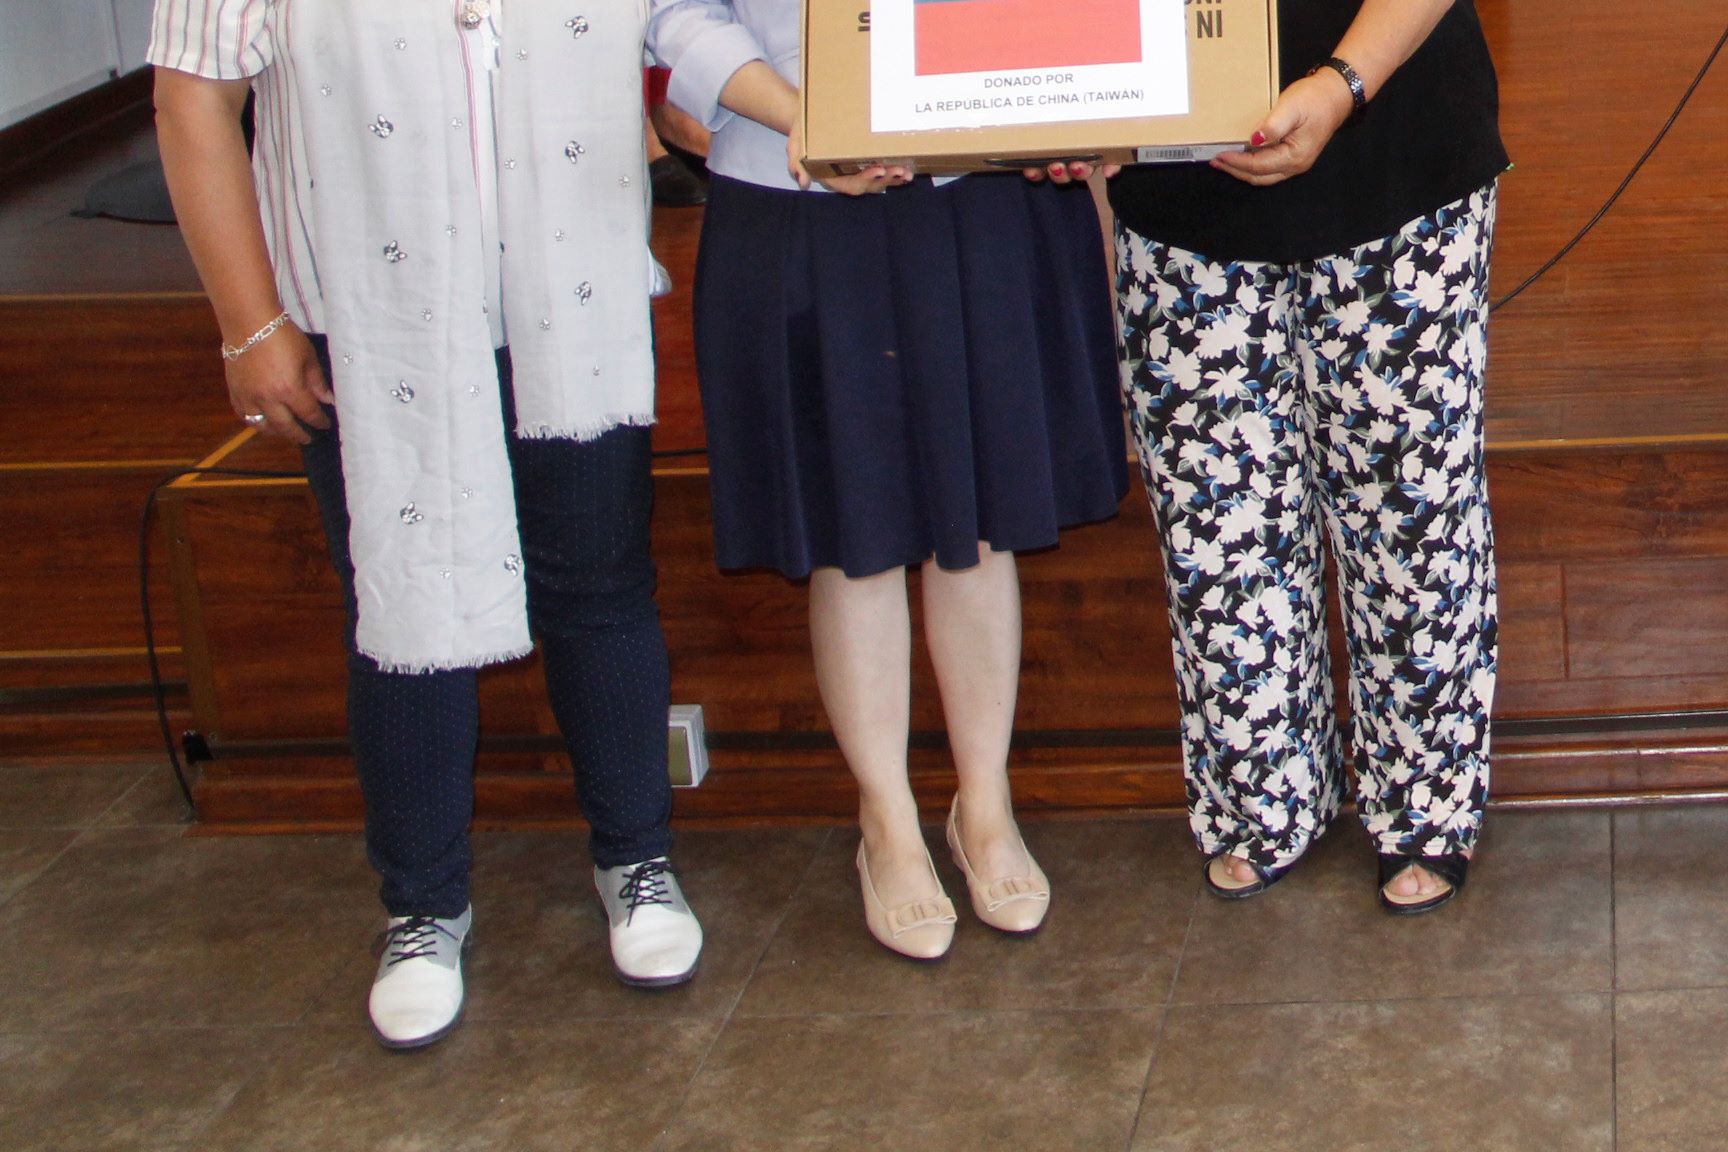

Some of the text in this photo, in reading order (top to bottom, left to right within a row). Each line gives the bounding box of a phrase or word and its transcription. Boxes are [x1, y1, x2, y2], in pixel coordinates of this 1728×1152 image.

[984, 73, 1074, 89] DONADO POR
[915, 103, 932, 113] LA
[1017, 95, 1034, 107] DE
[1038, 93, 1080, 105] CHINA
